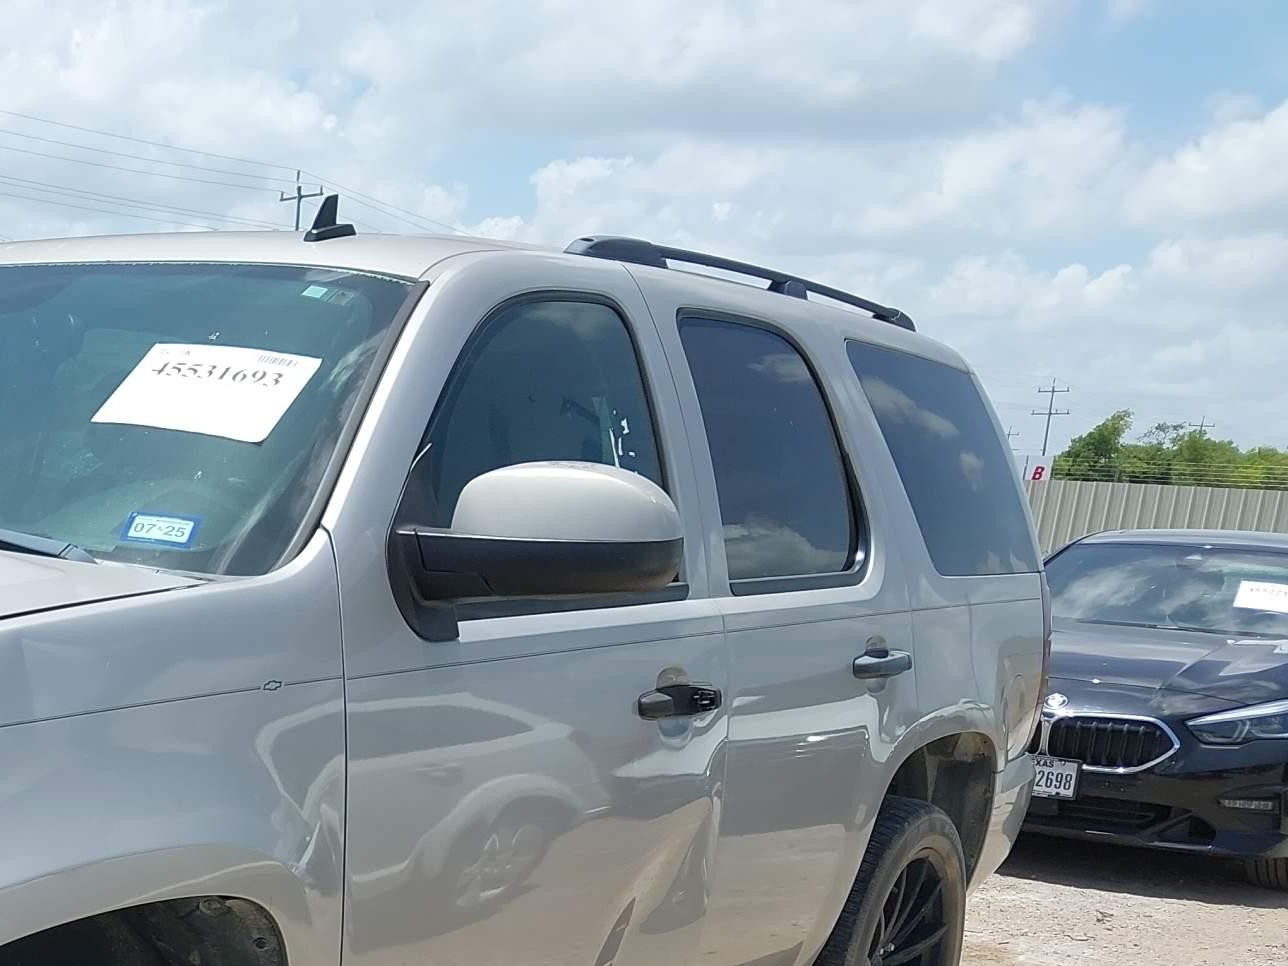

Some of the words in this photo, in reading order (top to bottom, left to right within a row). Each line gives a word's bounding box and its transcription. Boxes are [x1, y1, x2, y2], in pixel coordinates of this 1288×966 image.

[151, 361, 284, 388] 45531693
[1031, 465, 1045, 481] B
[133, 522, 157, 534] 07
[162, 525, 187, 538] 25
[1035, 769, 1073, 791] 2698
